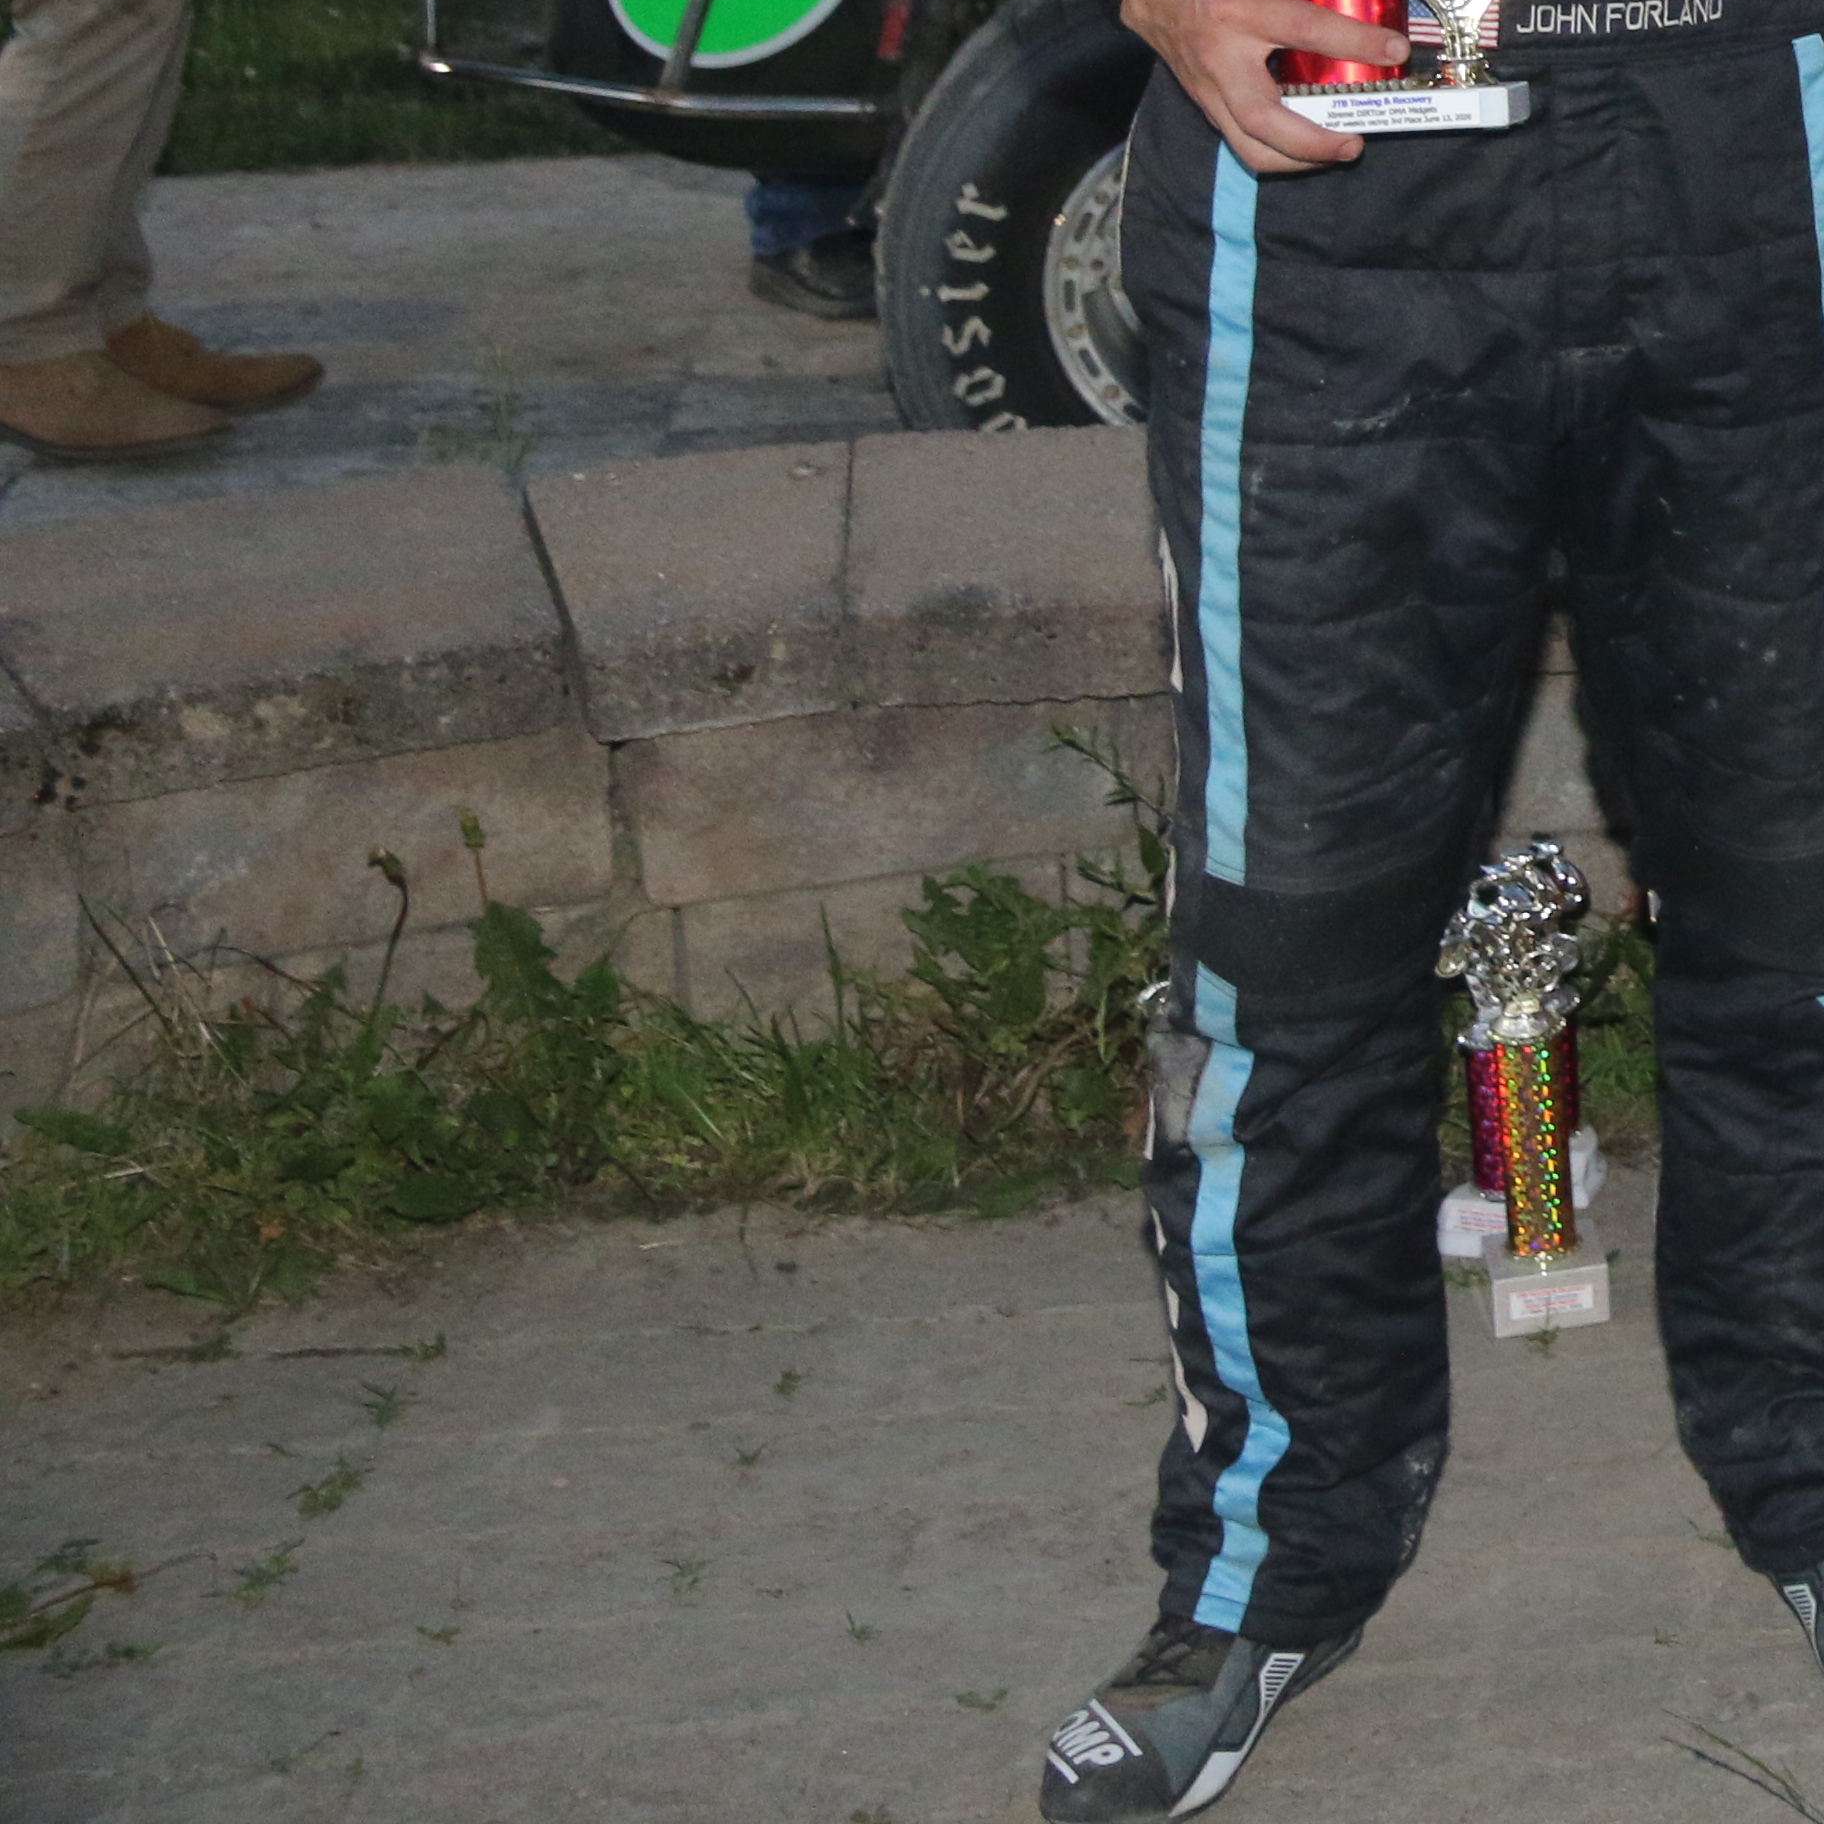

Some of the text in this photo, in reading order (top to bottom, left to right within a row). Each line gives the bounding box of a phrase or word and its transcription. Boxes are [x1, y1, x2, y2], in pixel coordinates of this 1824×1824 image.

[1350, 97, 1382, 108] Towing
[1392, 94, 1433, 106] Recovery
[1053, 1712, 1127, 1769] OMP
